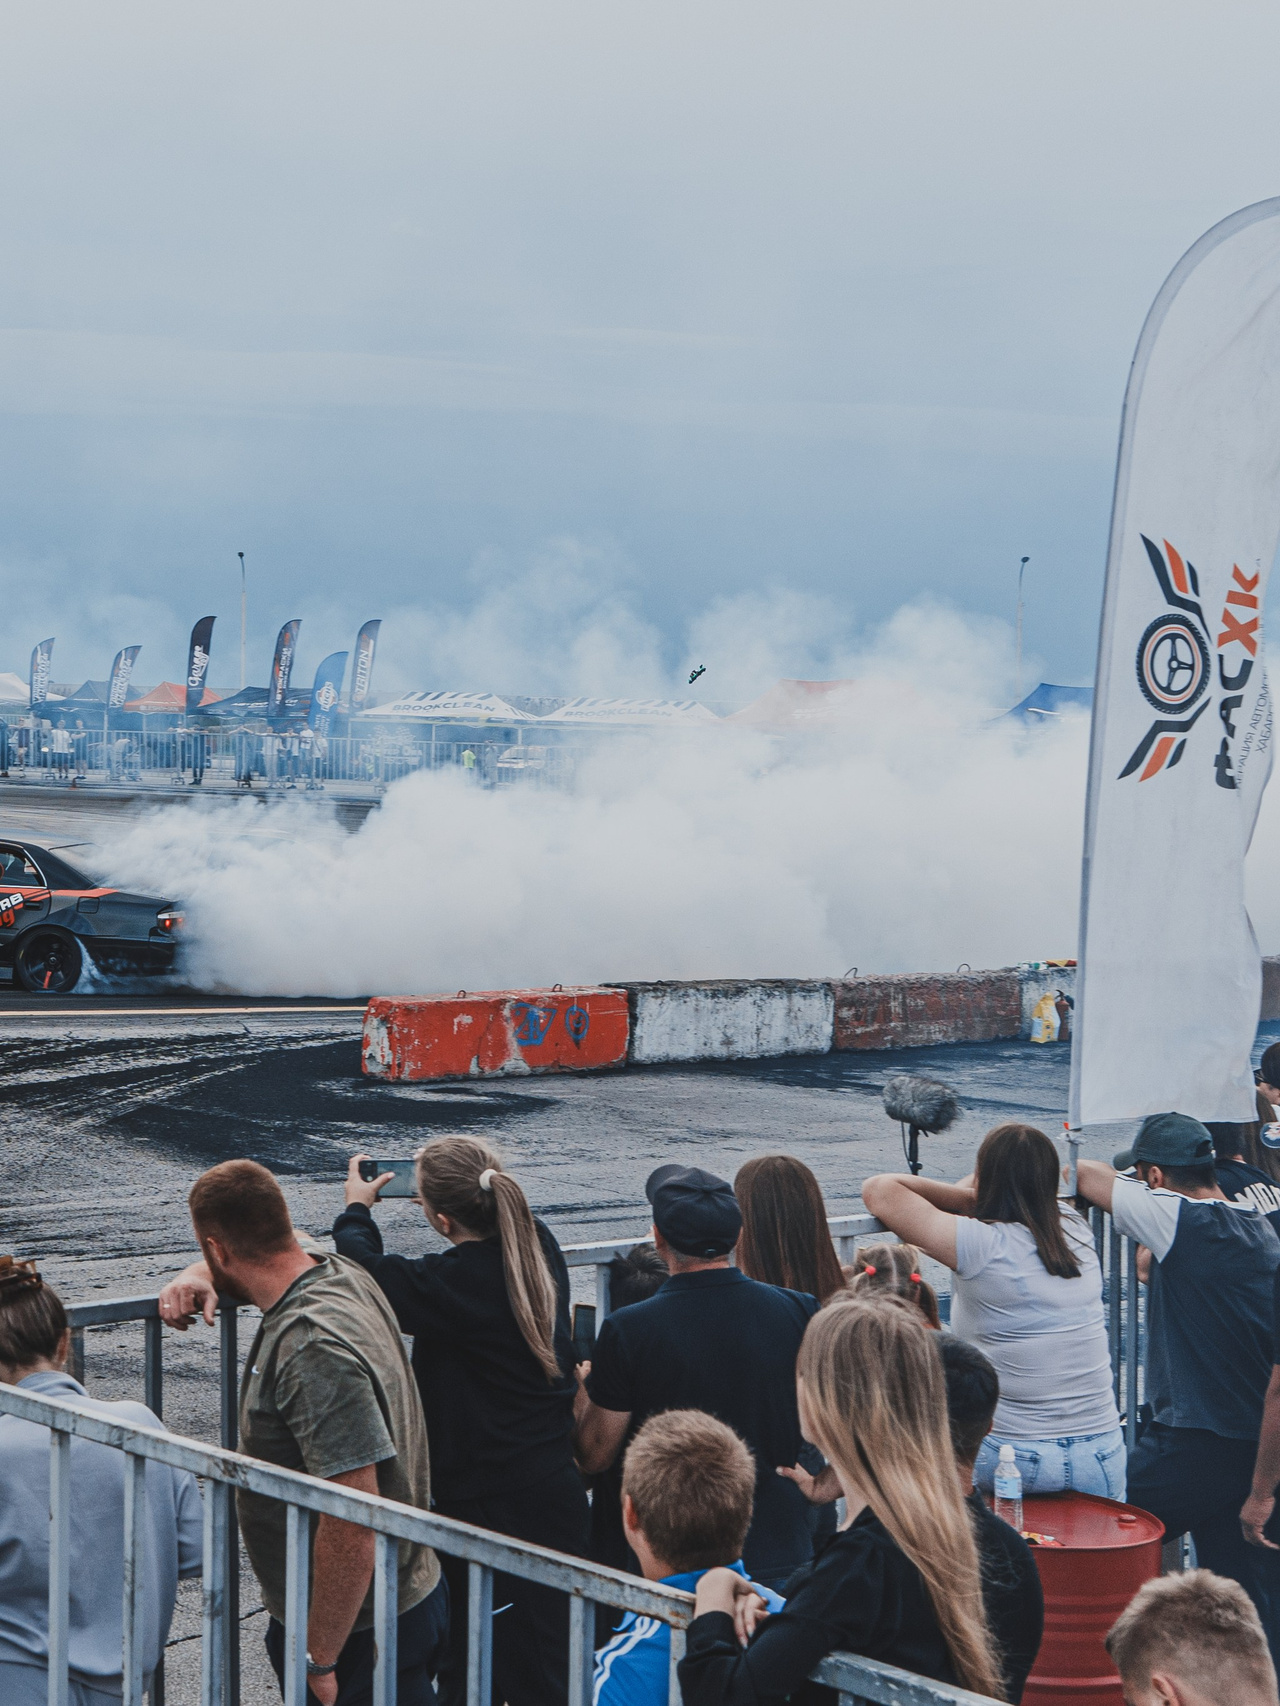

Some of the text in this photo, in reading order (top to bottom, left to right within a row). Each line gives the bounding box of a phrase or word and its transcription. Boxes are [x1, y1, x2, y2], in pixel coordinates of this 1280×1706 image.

[355, 649, 370, 697] TRITON
[320, 681, 334, 712] FUCHS
[392, 701, 496, 712] BROOKCLEAN
[563, 708, 673, 717] BROOKCLEAN
